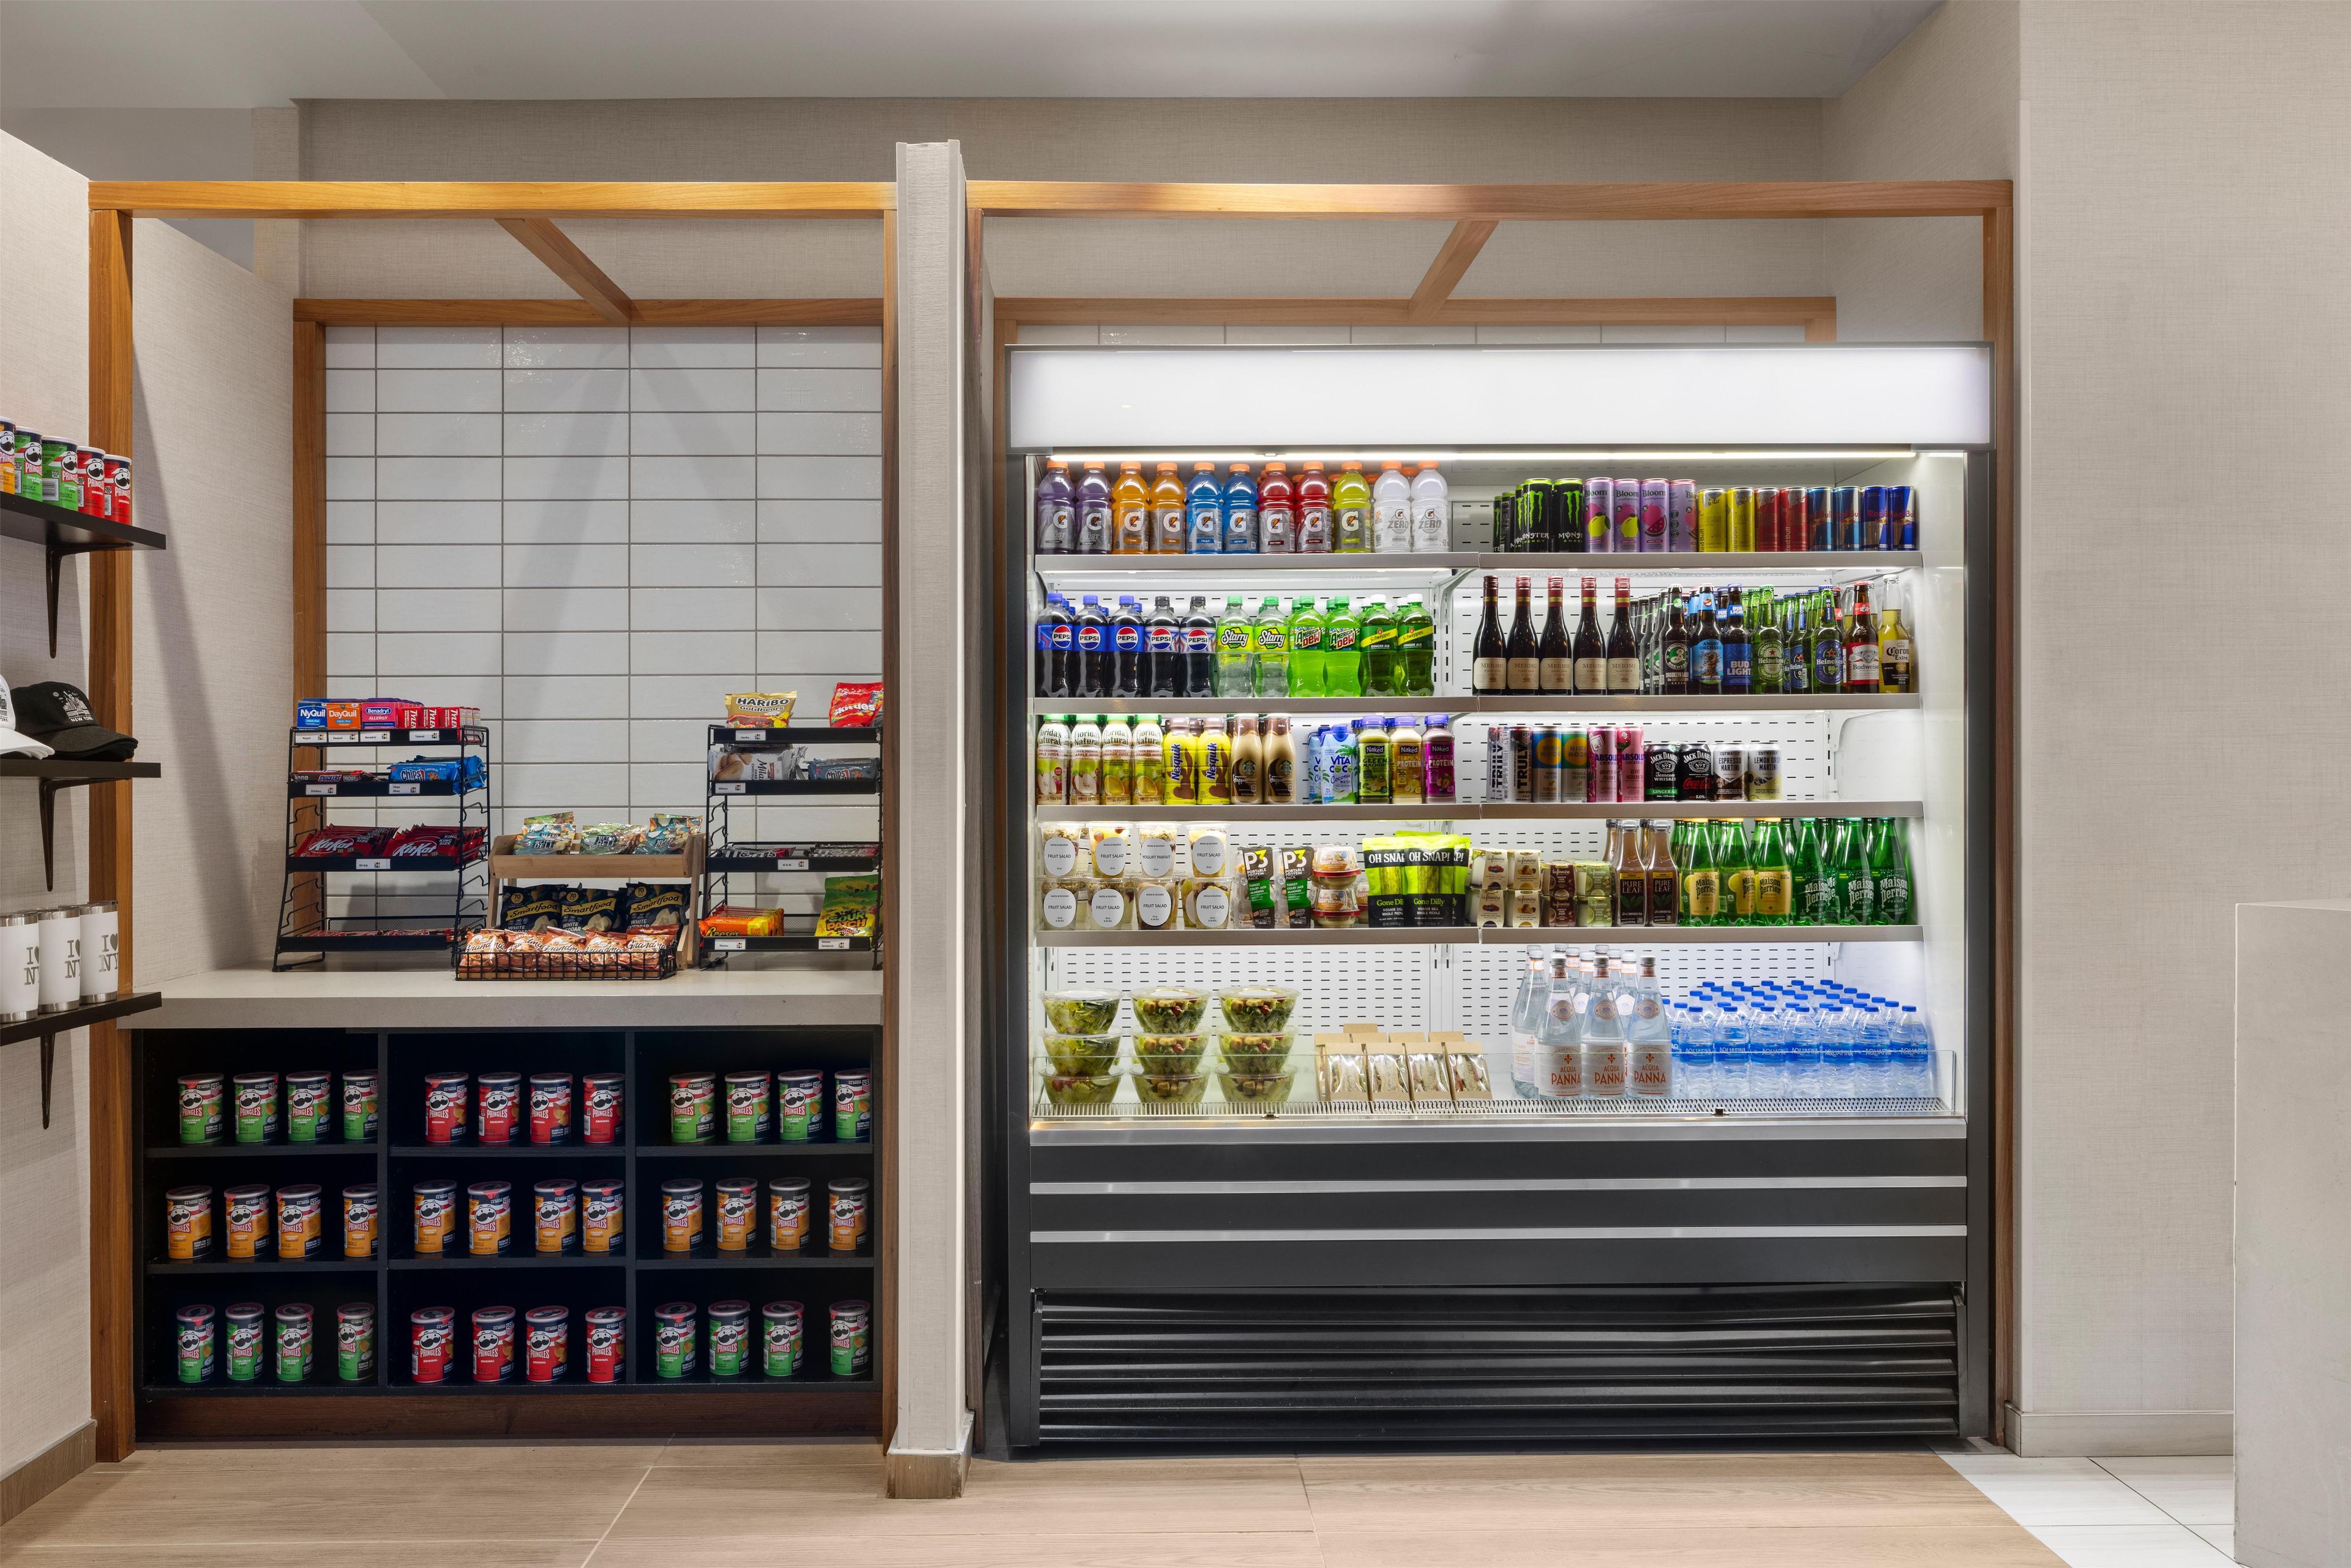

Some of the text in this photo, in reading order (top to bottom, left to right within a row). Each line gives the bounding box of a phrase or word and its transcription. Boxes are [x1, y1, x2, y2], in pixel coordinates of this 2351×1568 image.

[1053, 511, 1067, 528] G
[1125, 512, 1142, 531] G
[1163, 512, 1180, 532] G
[1196, 512, 1213, 531] G
[1230, 512, 1247, 532] G
[1419, 520, 1441, 529] ZERO
[1221, 629, 1249, 646] Starry
[1258, 629, 1285, 646] Starry
[1302, 634, 1321, 648] DEW
[737, 697, 790, 707] HARIBO
[301, 710, 325, 719] NyQuil
[329, 710, 356, 719] DayQuil
[1171, 744, 1183, 781] Nesquik
[1206, 743, 1219, 779] Nesquik
[1330, 755, 1350, 765] VITA
[1651, 754, 1662, 763] JACK
[1517, 745, 1528, 789] TRULY
[1244, 849, 1269, 870] P3
[1283, 849, 1307, 870] P3
[1409, 852, 1450, 861] OH SNAP!
[1760, 876, 1780, 887] Maison
[564, 901, 612, 913] Smartfood
[633, 895, 680, 911] Smartfood
[510, 902, 558, 918] Smartfood
[829, 910, 866, 922] SOUR
[827, 918, 867, 931] PATCH
[1551, 1073, 1581, 1085] PANNA
[1595, 1073, 1624, 1084] PANNA
[1634, 1071, 1666, 1083] PANNA
[182, 1107, 202, 1117] PRINGLES
[293, 1106, 313, 1116] PRINGLES
[487, 1109, 508, 1118] PRINGLES
[673, 1106, 694, 1116] PRINGLES
[784, 1106, 804, 1116] PRINGLES
[420, 1217, 440, 1227] PRINGLES
[724, 1216, 744, 1225] PRINGLES
[835, 1218, 854, 1227] PRINGLES
[231, 1223, 252, 1233] PRINGLES
[234, 1347, 252, 1357] PRINGLES
[592, 1346, 612, 1356] PRINGLES
[717, 1343, 737, 1352] PRINGLES
